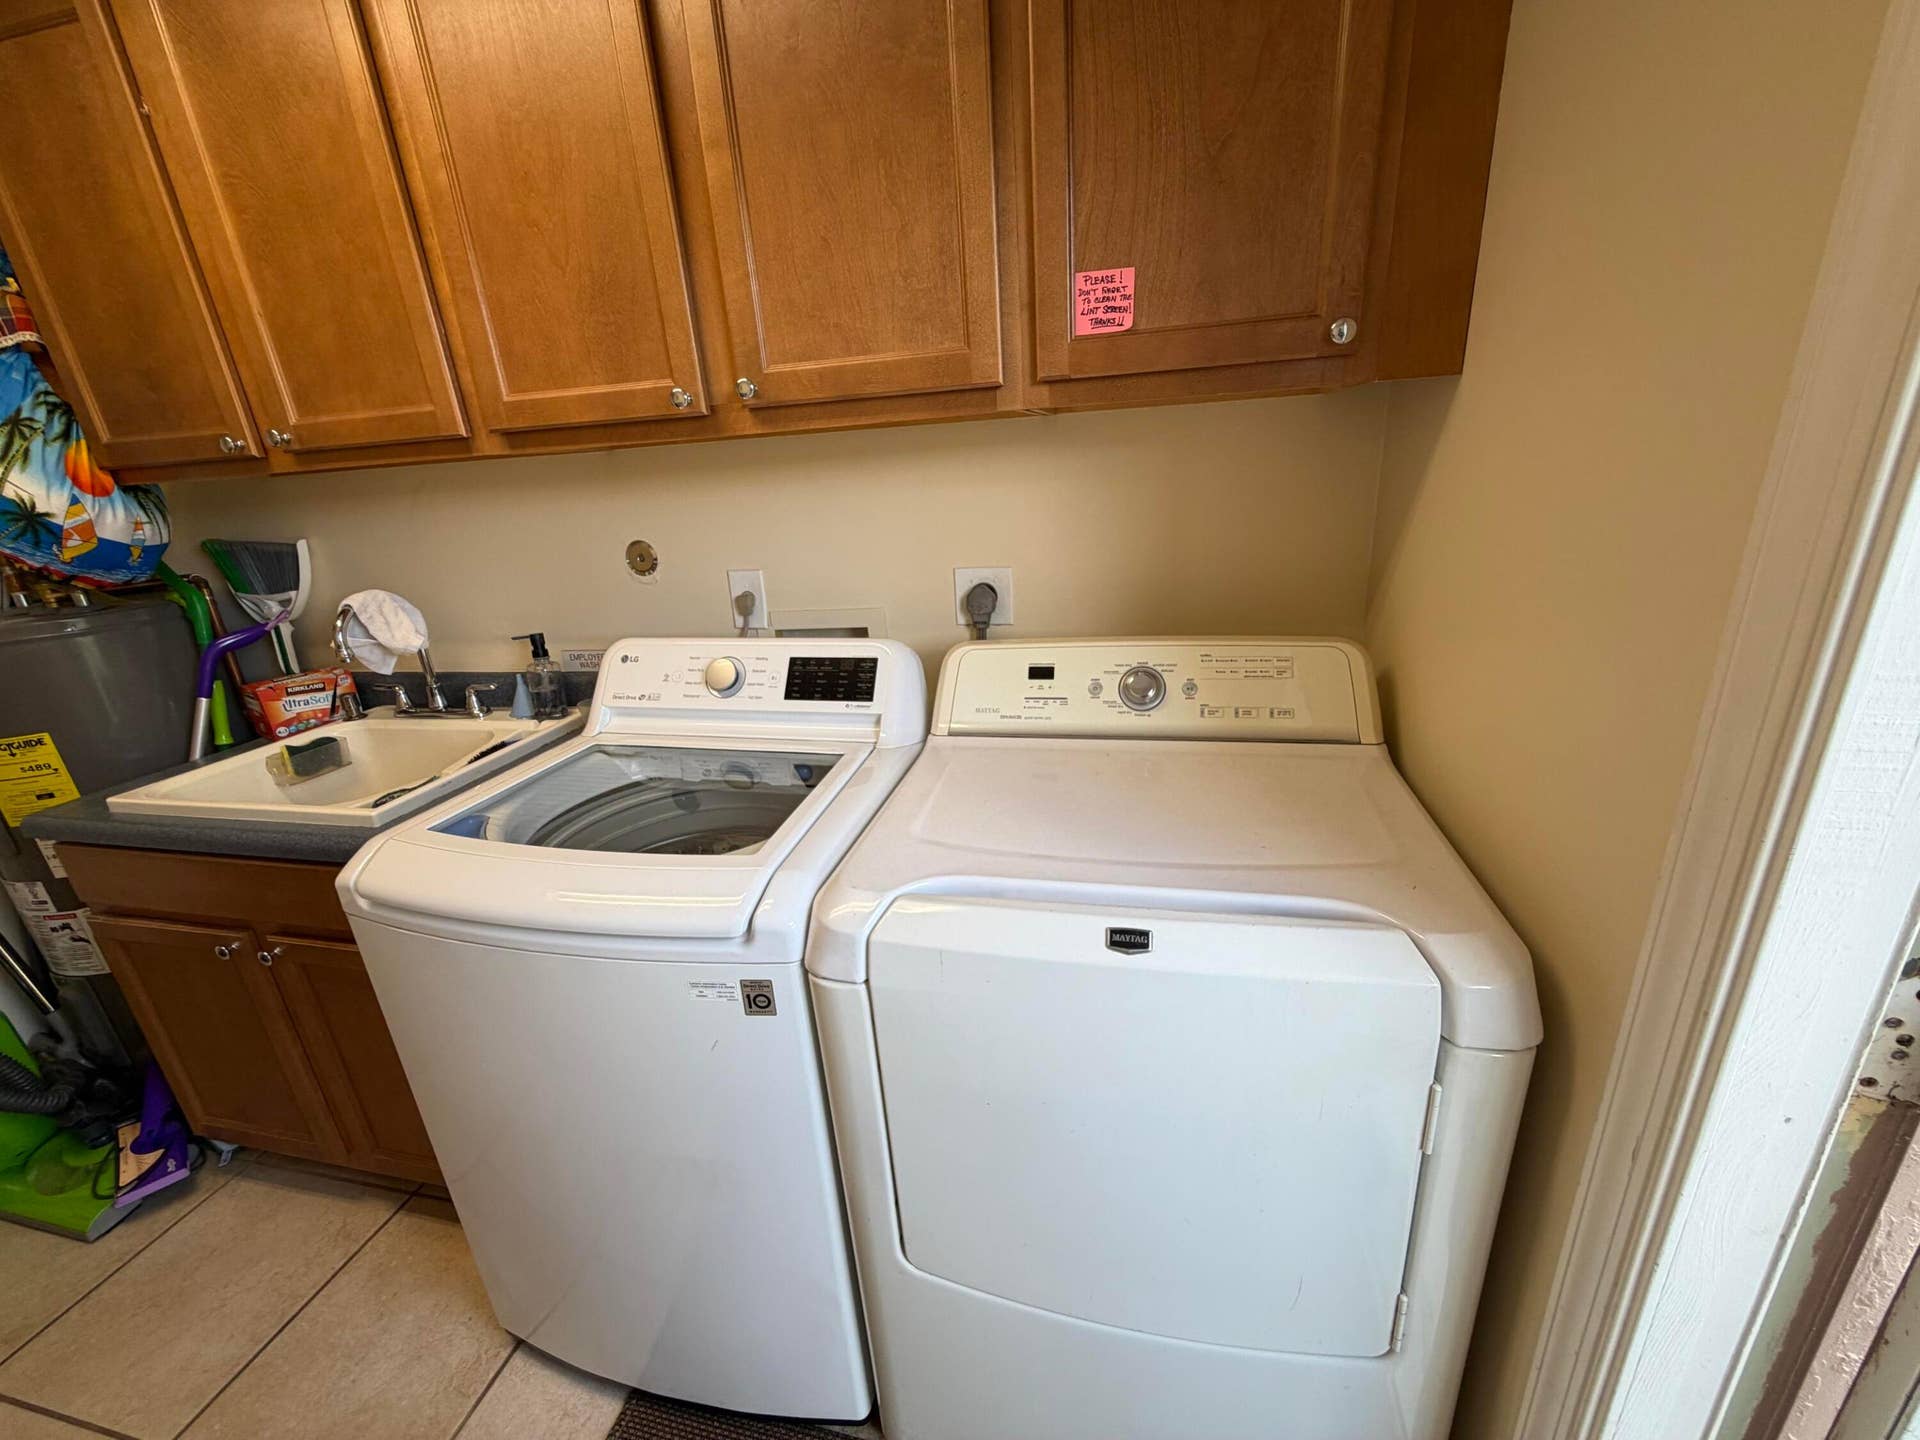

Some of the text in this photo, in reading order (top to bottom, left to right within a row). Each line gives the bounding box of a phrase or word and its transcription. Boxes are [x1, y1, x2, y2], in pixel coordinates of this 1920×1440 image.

[1093, 296, 1117, 304] CLEAN
[287, 682, 325, 694] KIRKLAND
[1111, 933, 1148, 944] MAYTAG
[746, 993, 772, 1010] 10
